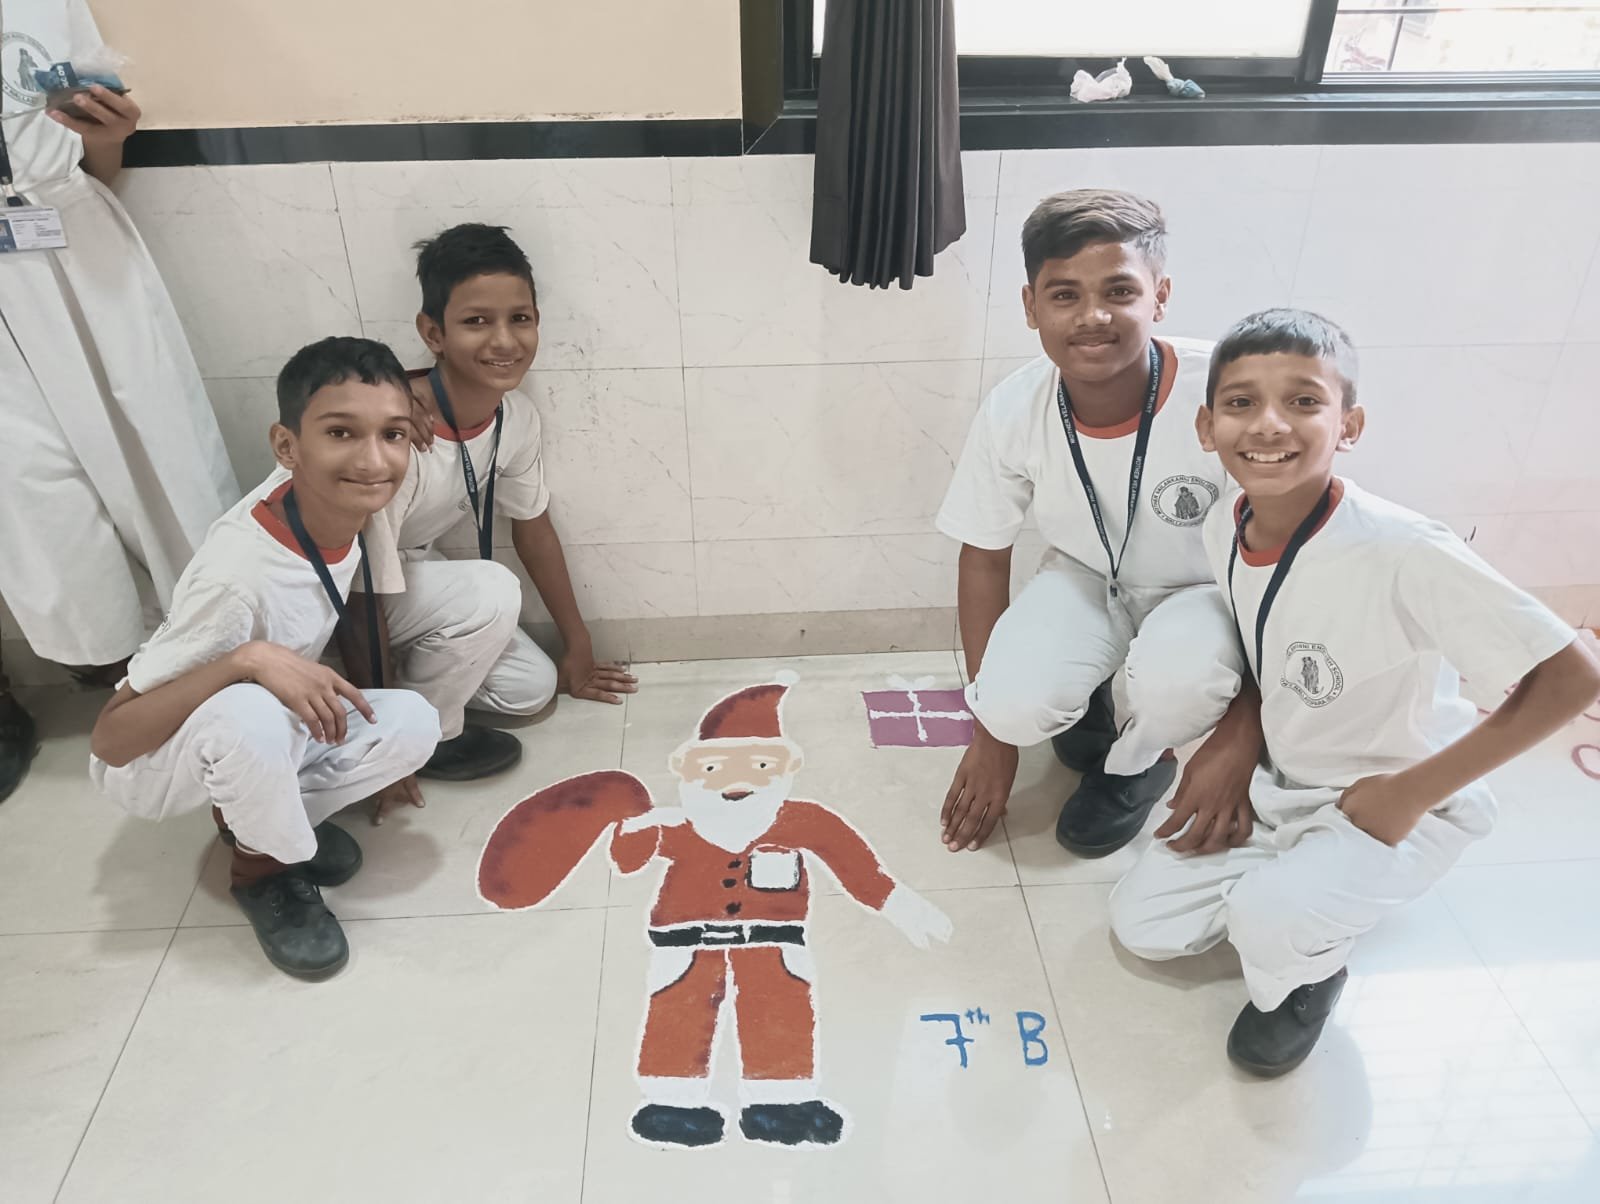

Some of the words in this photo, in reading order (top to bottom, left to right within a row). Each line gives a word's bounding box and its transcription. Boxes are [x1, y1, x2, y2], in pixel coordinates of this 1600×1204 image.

[1145, 392, 1156, 414] TRUST
[1064, 418, 1076, 444] MOTHER
[1134, 456, 1142, 480] MOTHER
[1332, 667, 1342, 691] SCHOOL
[920, 1007, 990, 1068] 7th
[1016, 1011, 1048, 1066] B
